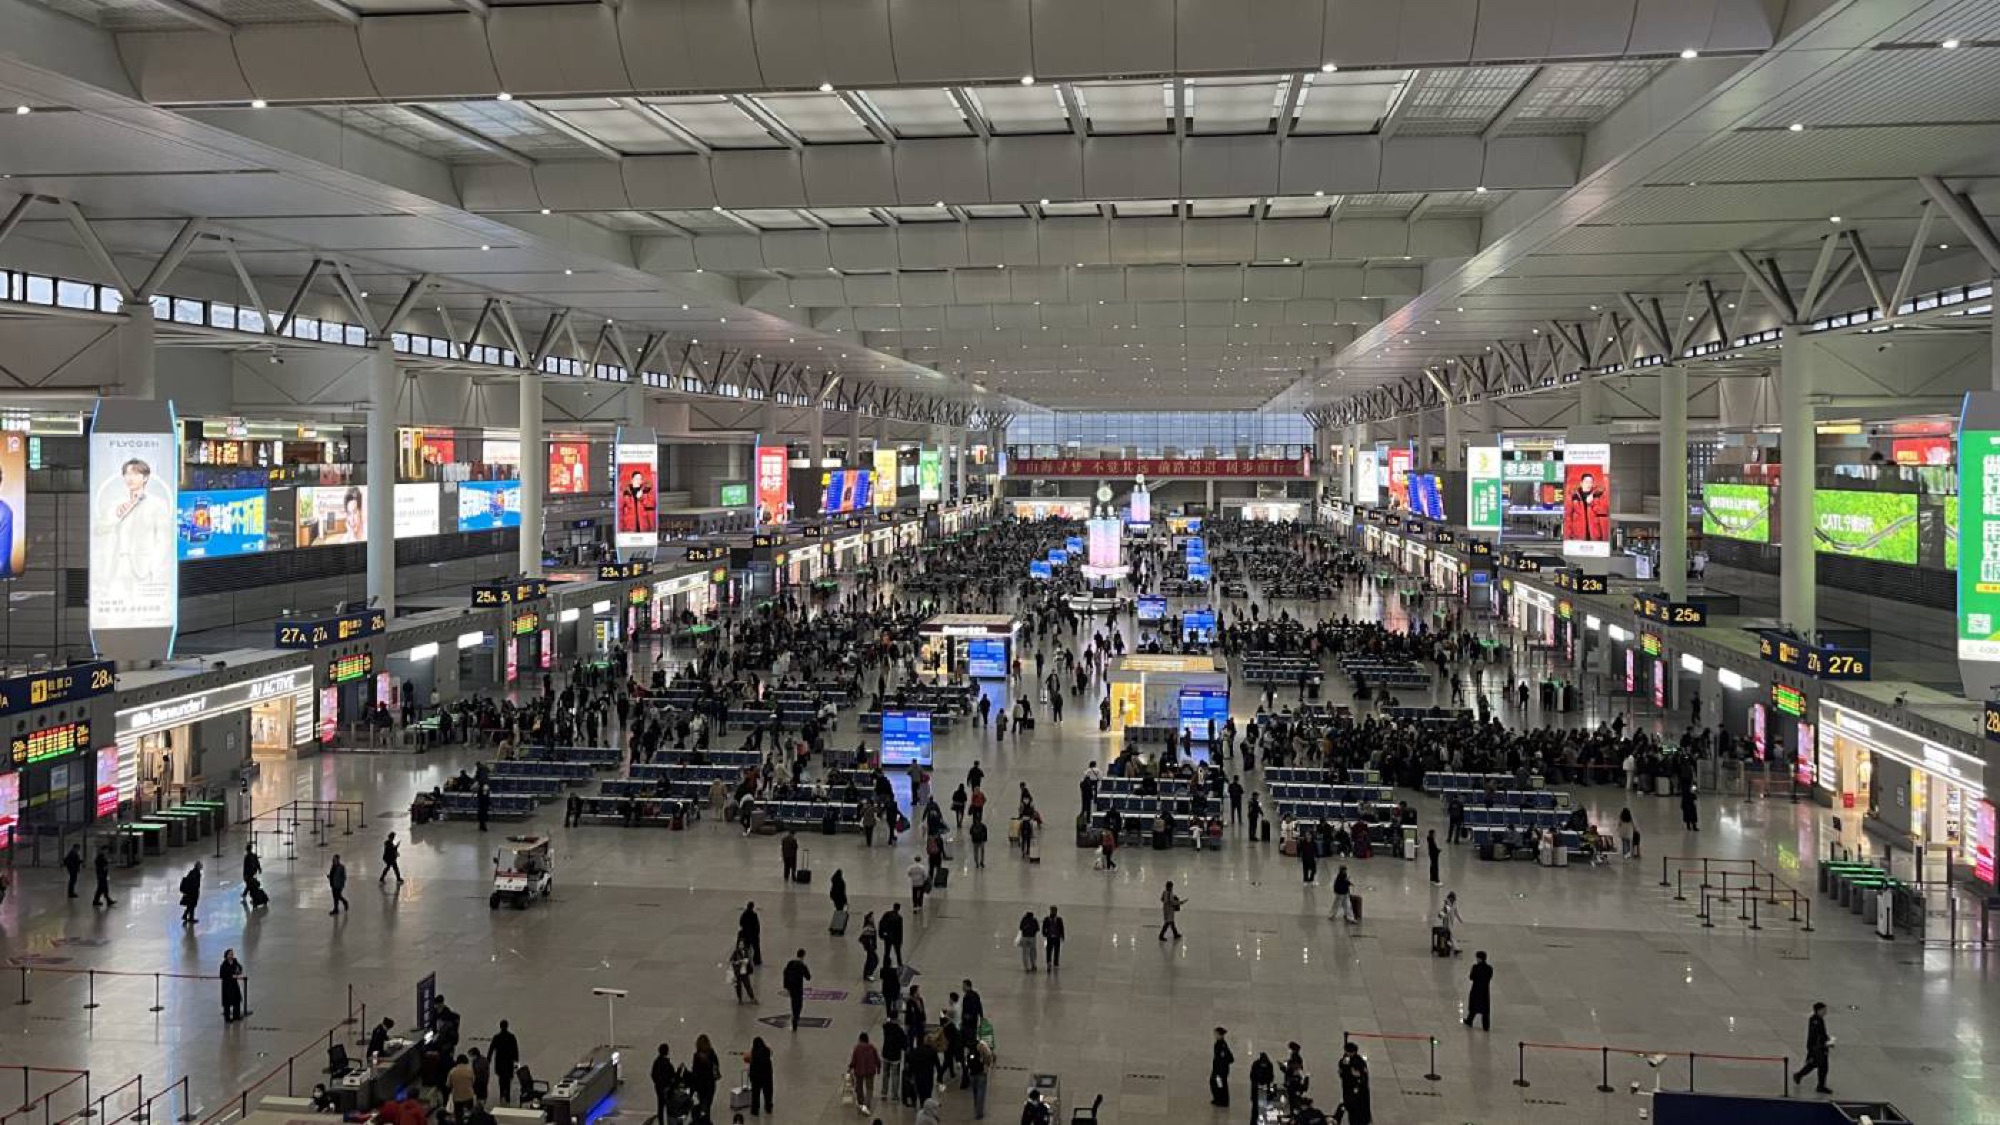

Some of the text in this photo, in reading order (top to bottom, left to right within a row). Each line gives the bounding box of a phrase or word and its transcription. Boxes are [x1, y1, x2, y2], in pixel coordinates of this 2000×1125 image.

[689, 550, 705, 559] 21A
[601, 567, 619, 577] 23A
[476, 590, 498, 602] 25A
[1675, 608, 1701, 621] 25B
[281, 628, 307, 643] 27A
[1828, 656, 1863, 674] 27B
[91, 669, 114, 689] 28A
